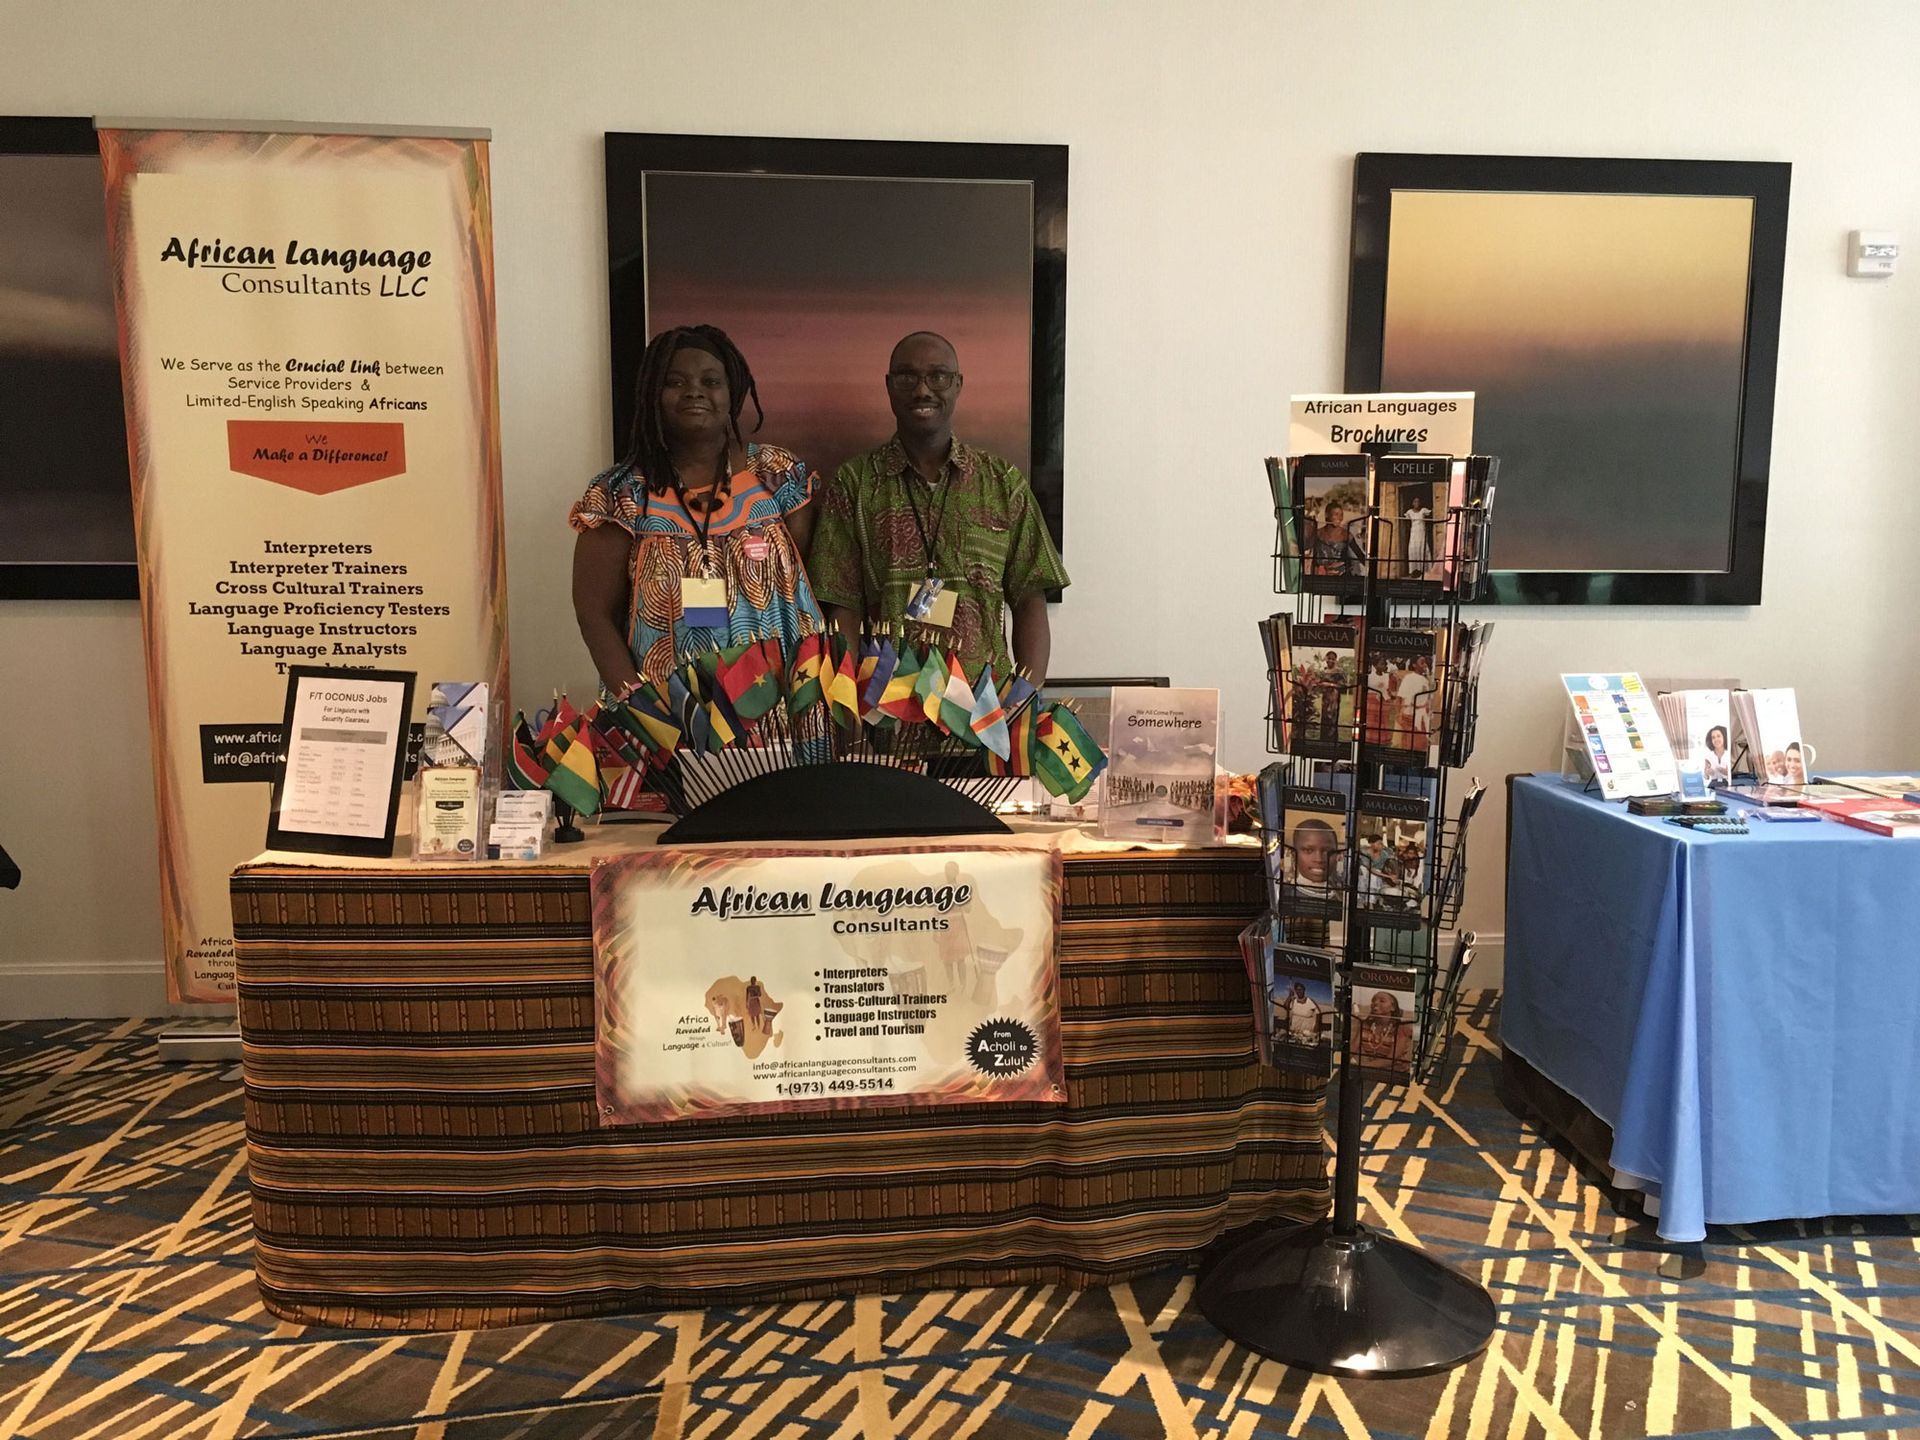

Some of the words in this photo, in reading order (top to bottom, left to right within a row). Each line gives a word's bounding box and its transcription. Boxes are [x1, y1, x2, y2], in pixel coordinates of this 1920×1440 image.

[161, 237, 276, 268] African
[286, 240, 432, 274] Language
[222, 272, 371, 296] Consultants
[380, 275, 428, 297] LLC
[161, 357, 186, 371] We
[190, 358, 234, 372] Serve
[238, 361, 253, 372] as
[257, 359, 281, 373] the
[285, 358, 345, 374] Crucial
[350, 359, 381, 377] Link
[385, 361, 444, 376] between
[228, 377, 281, 390] Service
[285, 377, 352, 391] Providers
[360, 379, 371, 391] &
[186, 394, 296, 410] Limited-English
[301, 397, 364, 412] Speaking
[369, 397, 428, 411] Africans
[1304, 400, 1362, 414] African
[1367, 401, 1457, 415] Languages
[305, 433, 328, 445] We
[1331, 425, 1428, 443] Brochures
[253, 449, 294, 463] Make
[299, 452, 308, 461] a
[312, 449, 388, 463] Difference!
[1393, 463, 1435, 474] KPELLE
[264, 541, 372, 556] Interpreters
[230, 561, 328, 577] Interpreter
[332, 562, 407, 575] Trainers
[216, 581, 267, 595] Cross
[272, 582, 345, 595] Cultural
[349, 583, 423, 596] Trainers
[189, 602, 278, 617] Language
[284, 603, 385, 618] Proficiency
[389, 603, 450, 616] Testers
[228, 623, 314, 638] Language
[319, 623, 417, 636] Instructors
[1296, 630, 1349, 642] LINGALA
[1375, 634, 1429, 646] LUGANDA
[241, 642, 327, 658] Language
[332, 642, 407, 657] Analysts
[309, 692, 323, 700] F/T
[325, 692, 365, 702] OCONUS
[366, 695, 387, 703] Jobs
[1128, 715, 1202, 728] Somewhere
[1294, 793, 1335, 806] MAASAI
[1366, 801, 1419, 813] MALAGASY
[691, 885, 810, 921] African
[819, 881, 972, 915] Language
[833, 917, 949, 934] Consultants
[200, 937, 232, 946] Africa
[186, 949, 234, 958] Revealed
[1285, 953, 1318, 967] NAMA
[208, 959, 235, 967] throu
[194, 971, 235, 981] Languag
[823, 968, 888, 980] Interpreters
[1360, 971, 1410, 984] OROMO
[824, 982, 884, 993] Translators
[824, 995, 900, 1008] Cross-Cultural
[903, 994, 947, 1004] Trainers
[678, 1015, 709, 1024] Africa
[824, 1010, 875, 1024] Language
[878, 1009, 936, 1020] Instructors
[676, 1026, 710, 1035] Revealed
[824, 1026, 857, 1038] Travel
[859, 1025, 879, 1036] and
[881, 1024, 924, 1036] Tourism
[993, 1030, 1011, 1038] from
[663, 1043, 699, 1052] Language
[977, 1039, 1016, 1053] Acholi
[753, 1055, 917, 1071] info@africanlanguageconsultants.com
[995, 1053, 1025, 1067] Zulu!
[753, 1065, 917, 1080] www.africanlanguageconsultants.com
[776, 1082, 824, 1096] 1-(973)
[829, 1078, 893, 1092] 449-5514
